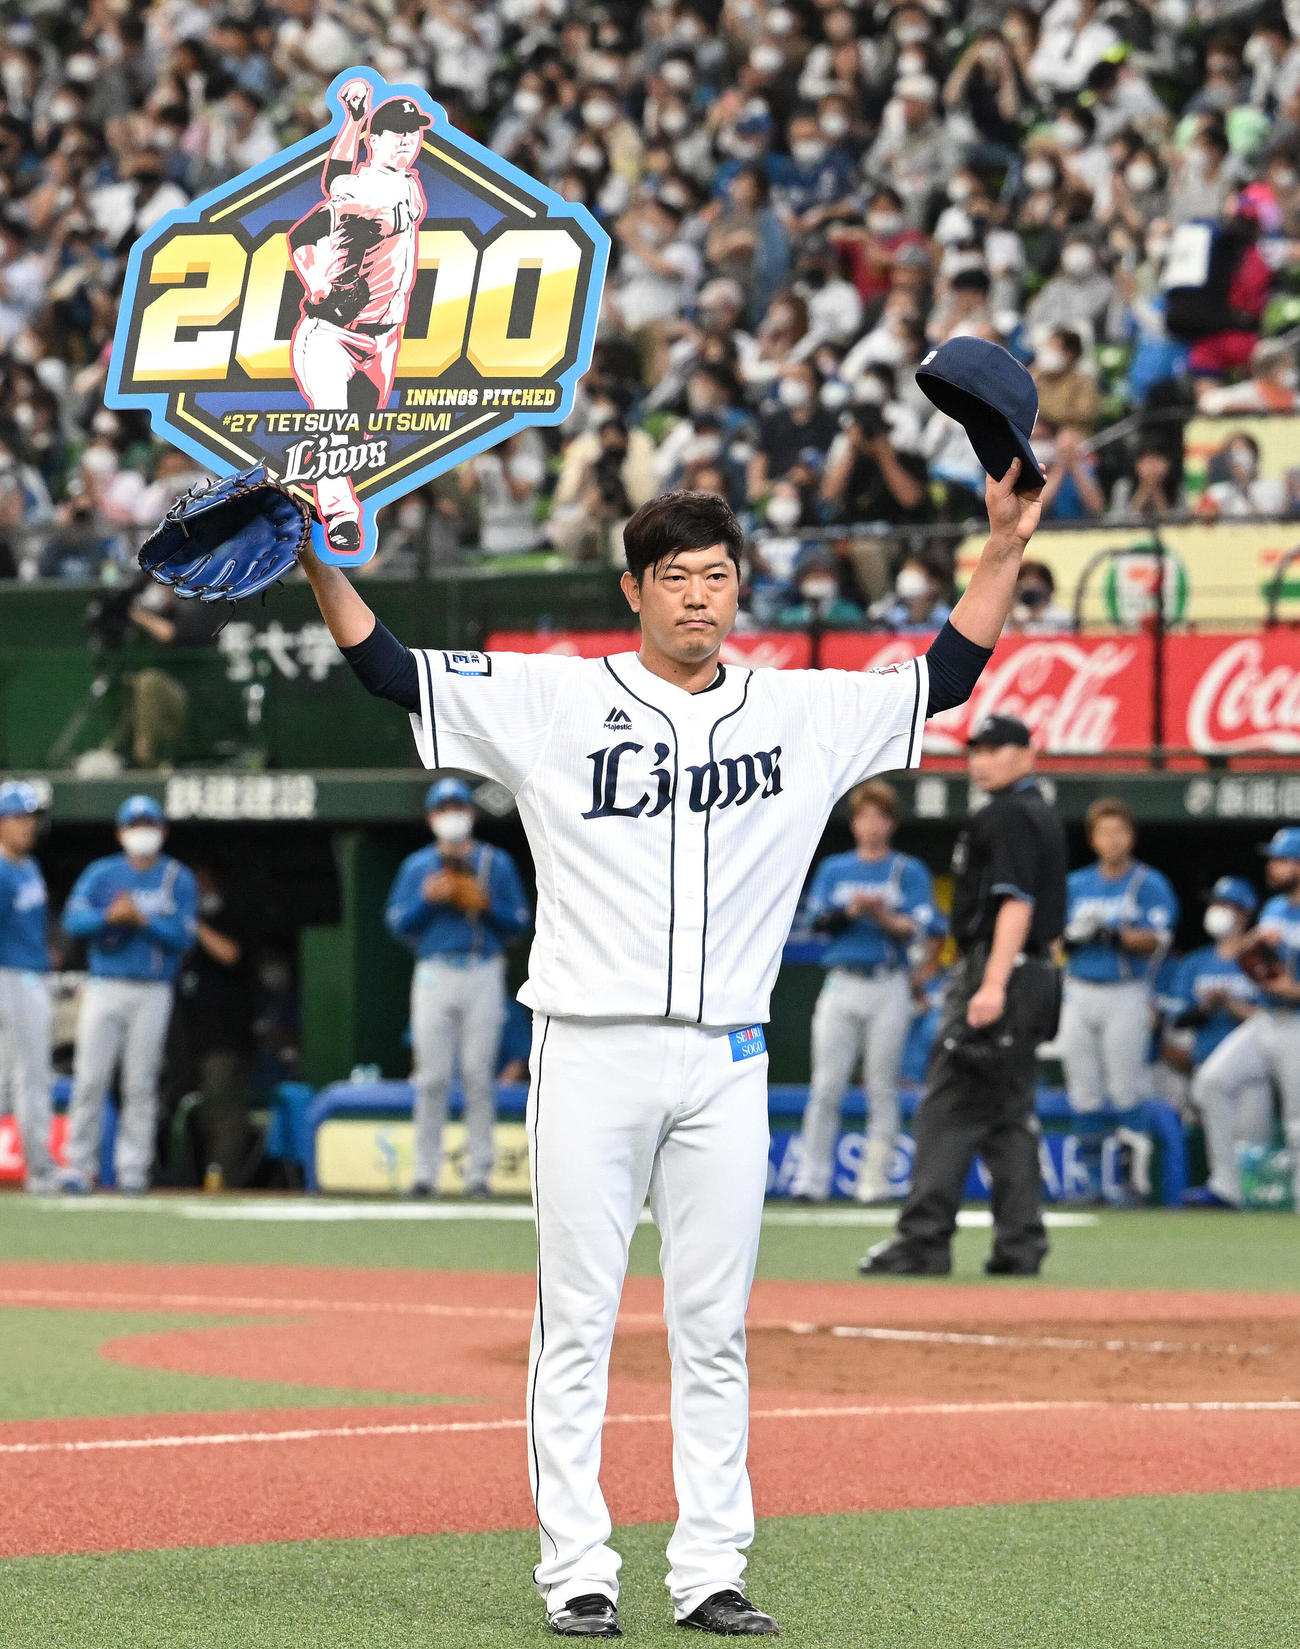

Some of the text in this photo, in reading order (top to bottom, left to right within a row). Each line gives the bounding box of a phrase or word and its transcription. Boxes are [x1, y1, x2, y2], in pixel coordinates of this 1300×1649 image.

[402, 102, 415, 113] L
[405, 388, 556, 406] INNINGS PITCHED
[222, 412, 452, 433] #27 TETSUYA UTSUMI
[279, 437, 388, 485] Lions
[603, 723, 633, 732] Majestic
[580, 741, 784, 820] Lions
[741, 1040, 764, 1057] SOGO
